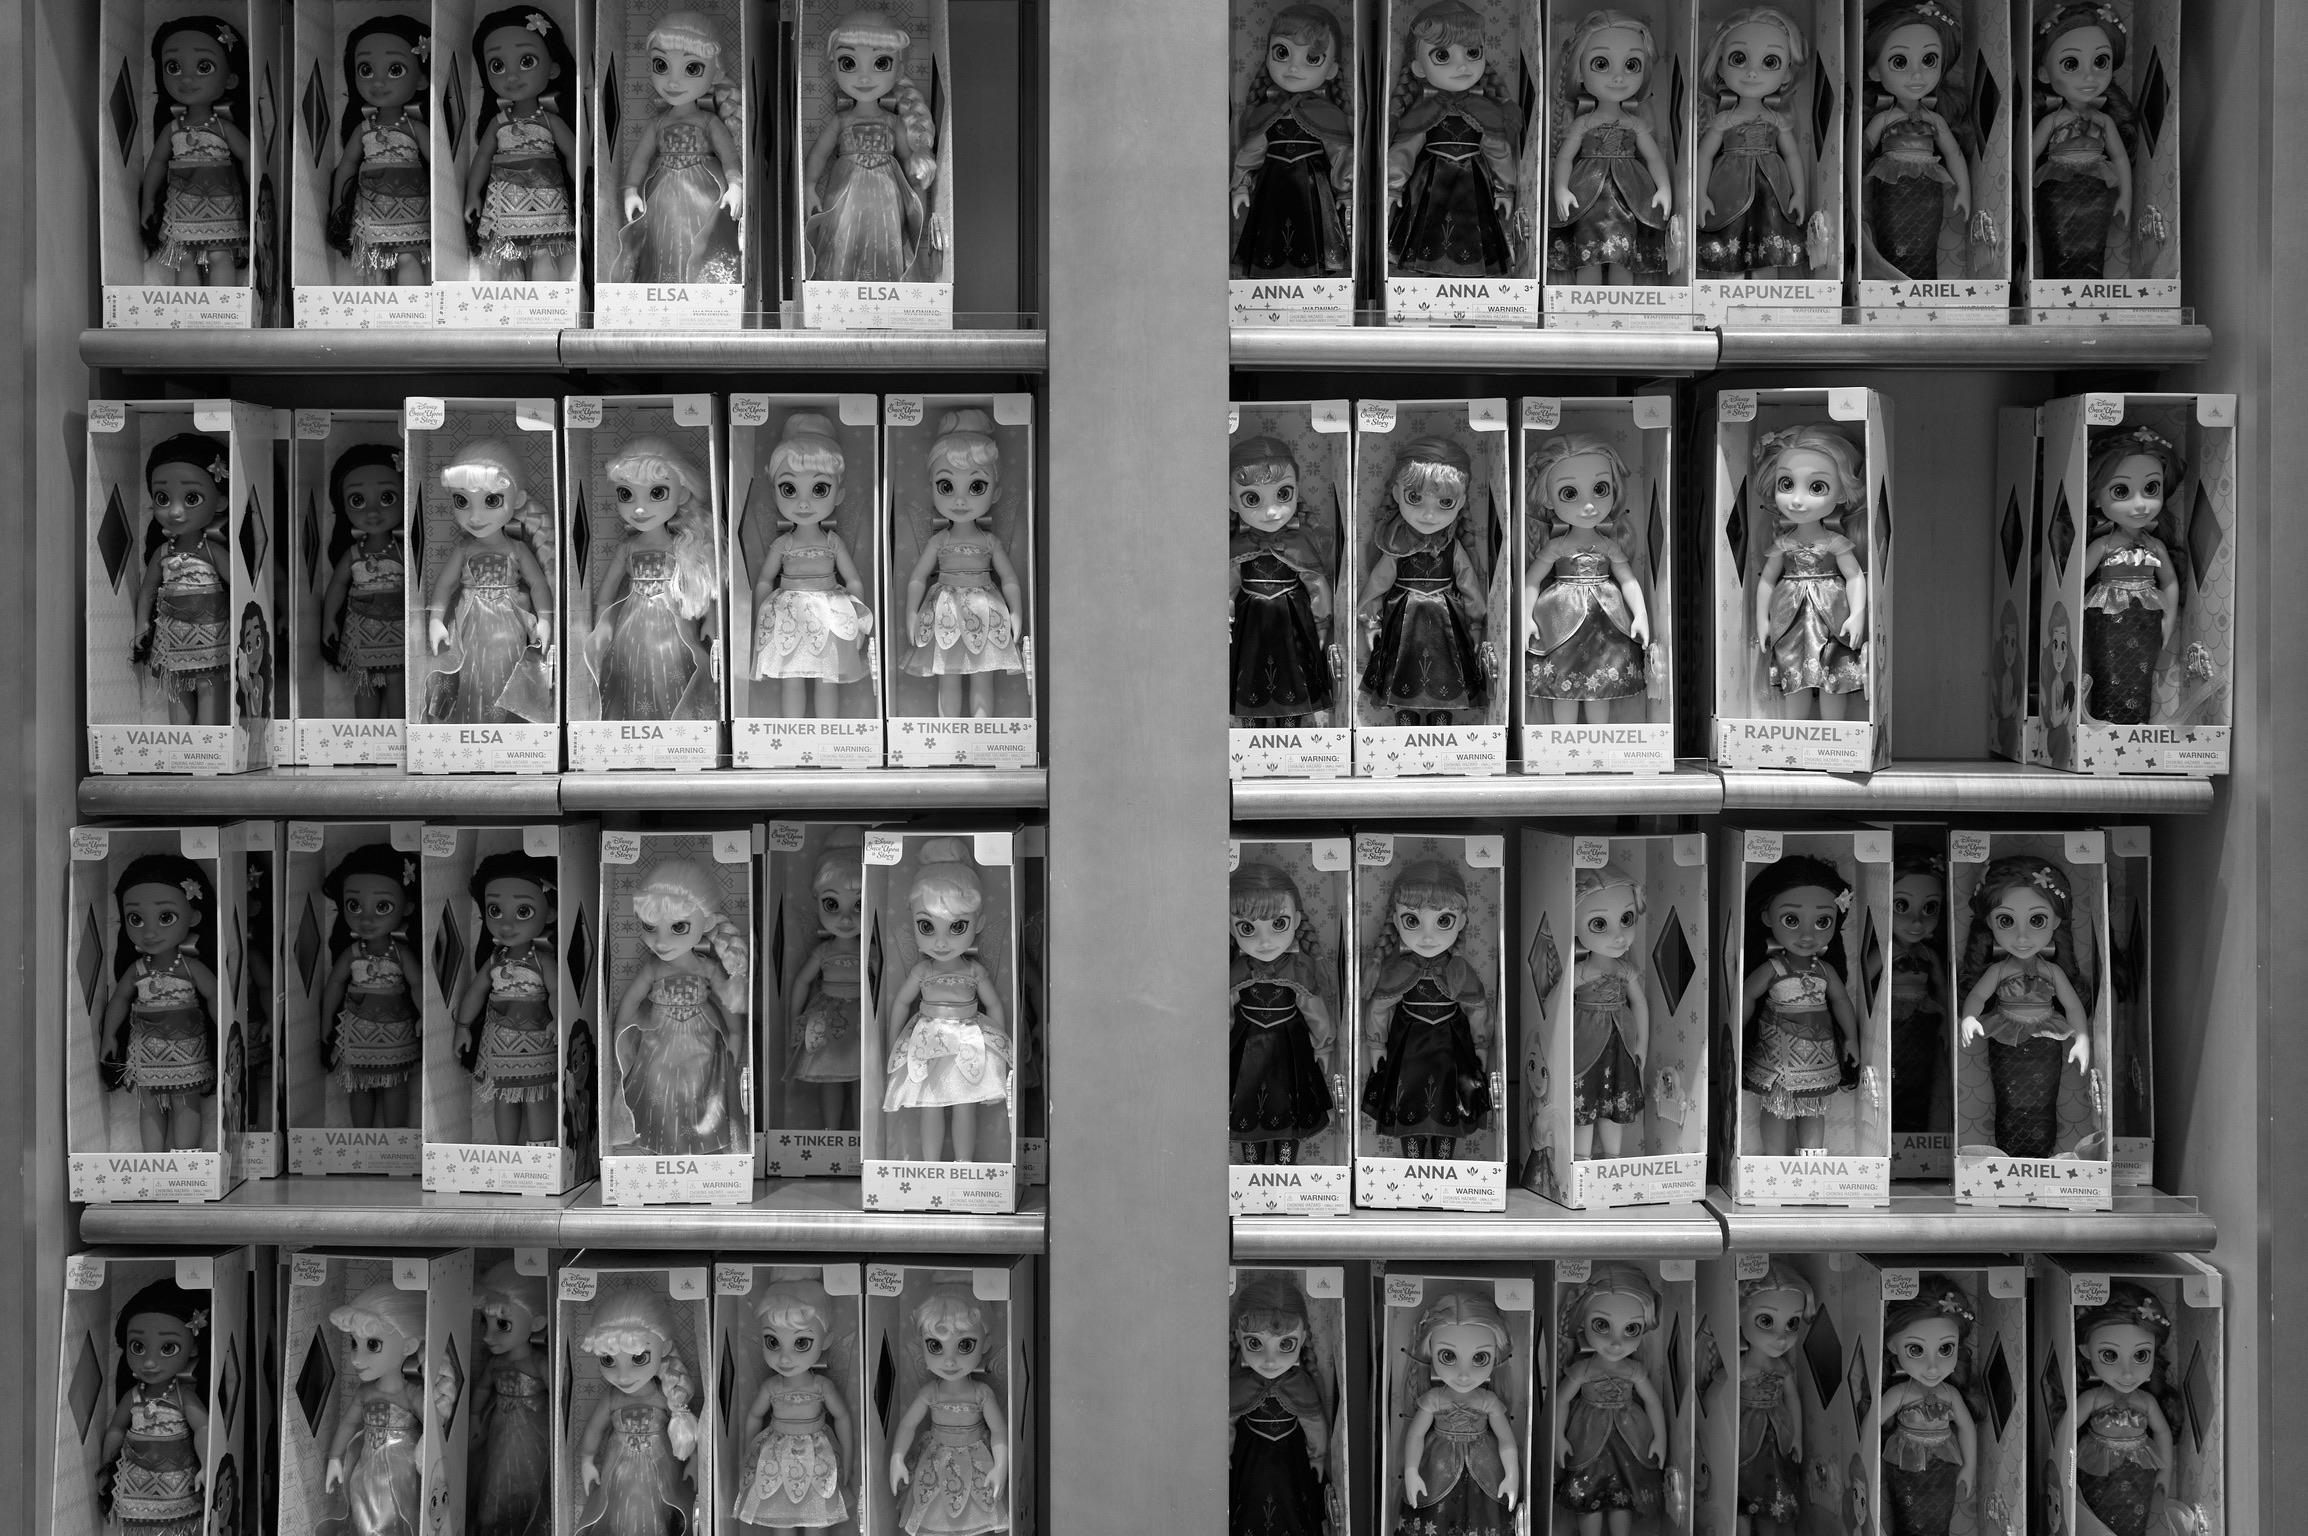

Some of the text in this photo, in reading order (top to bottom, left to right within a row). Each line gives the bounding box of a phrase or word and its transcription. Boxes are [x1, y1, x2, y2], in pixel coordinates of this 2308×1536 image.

[472, 287, 539, 300] VAIANA
[647, 288, 689, 301] ELSA
[858, 287, 900, 301] ELSA
[1251, 286, 1304, 299] ANNA
[1436, 284, 1489, 298] ANNA
[1720, 285, 1815, 299] RAPUNZEL
[1909, 284, 1960, 297] ARIEL
[2081, 285, 2132, 298] ARIEL
[142, 291, 210, 304] VAIANA
[332, 291, 398, 304] VAIANA
[1571, 291, 1666, 305] RAPUNZEL
[200, 312, 239, 320] WARNING:
[389, 312, 429, 320] WARNING:
[529, 308, 568, 316] WARNING:
[219, 730, 228, 738] 3+
[332, 724, 397, 737] VAIANA
[621, 726, 663, 739] ELSA
[763, 724, 854, 735] TINKER BELL
[917, 723, 1008, 734] TINKER BELL
[1745, 725, 1842, 741] RAPUNZEL
[127, 731, 193, 745] VAIANA
[460, 730, 503, 743] ELSA
[1249, 735, 1302, 748] ANNA
[1405, 733, 1458, 747] ANNA
[1552, 730, 1647, 744] RAPUNZEL
[2128, 730, 2180, 743] ARIEL
[506, 751, 545, 759] WARNING:
[1300, 755, 1340, 763] WARNING:
[1624, 751, 1664, 759] WARNING:
[1817, 749, 1857, 757] WARNING:
[325, 1133, 390, 1146] VAIANA
[794, 1136, 844, 1147] TINKER
[459, 1149, 522, 1164] VAIANA
[109, 1159, 178, 1172] VAIANA
[656, 1161, 698, 1174] ELSA
[1404, 1165, 1457, 1179] ANNA
[1596, 1161, 1683, 1180] RAPUNZEL
[1780, 1161, 1848, 1175] VAIANA
[2007, 1164, 2060, 1178] ARIEL
[513, 1171, 552, 1179] WARNING:
[892, 1167, 984, 1180] TINKER BELL
[1248, 1173, 1301, 1186] ANNA
[702, 1181, 742, 1189] WARNING:
[1455, 1187, 1495, 1195] WARNING:
[1661, 1180, 1697, 1190] WARNING:
[1838, 1183, 1878, 1191] WARNING:
[2060, 1187, 2099, 1195] WARNING:
[963, 1190, 1003, 1198] WARNING:
